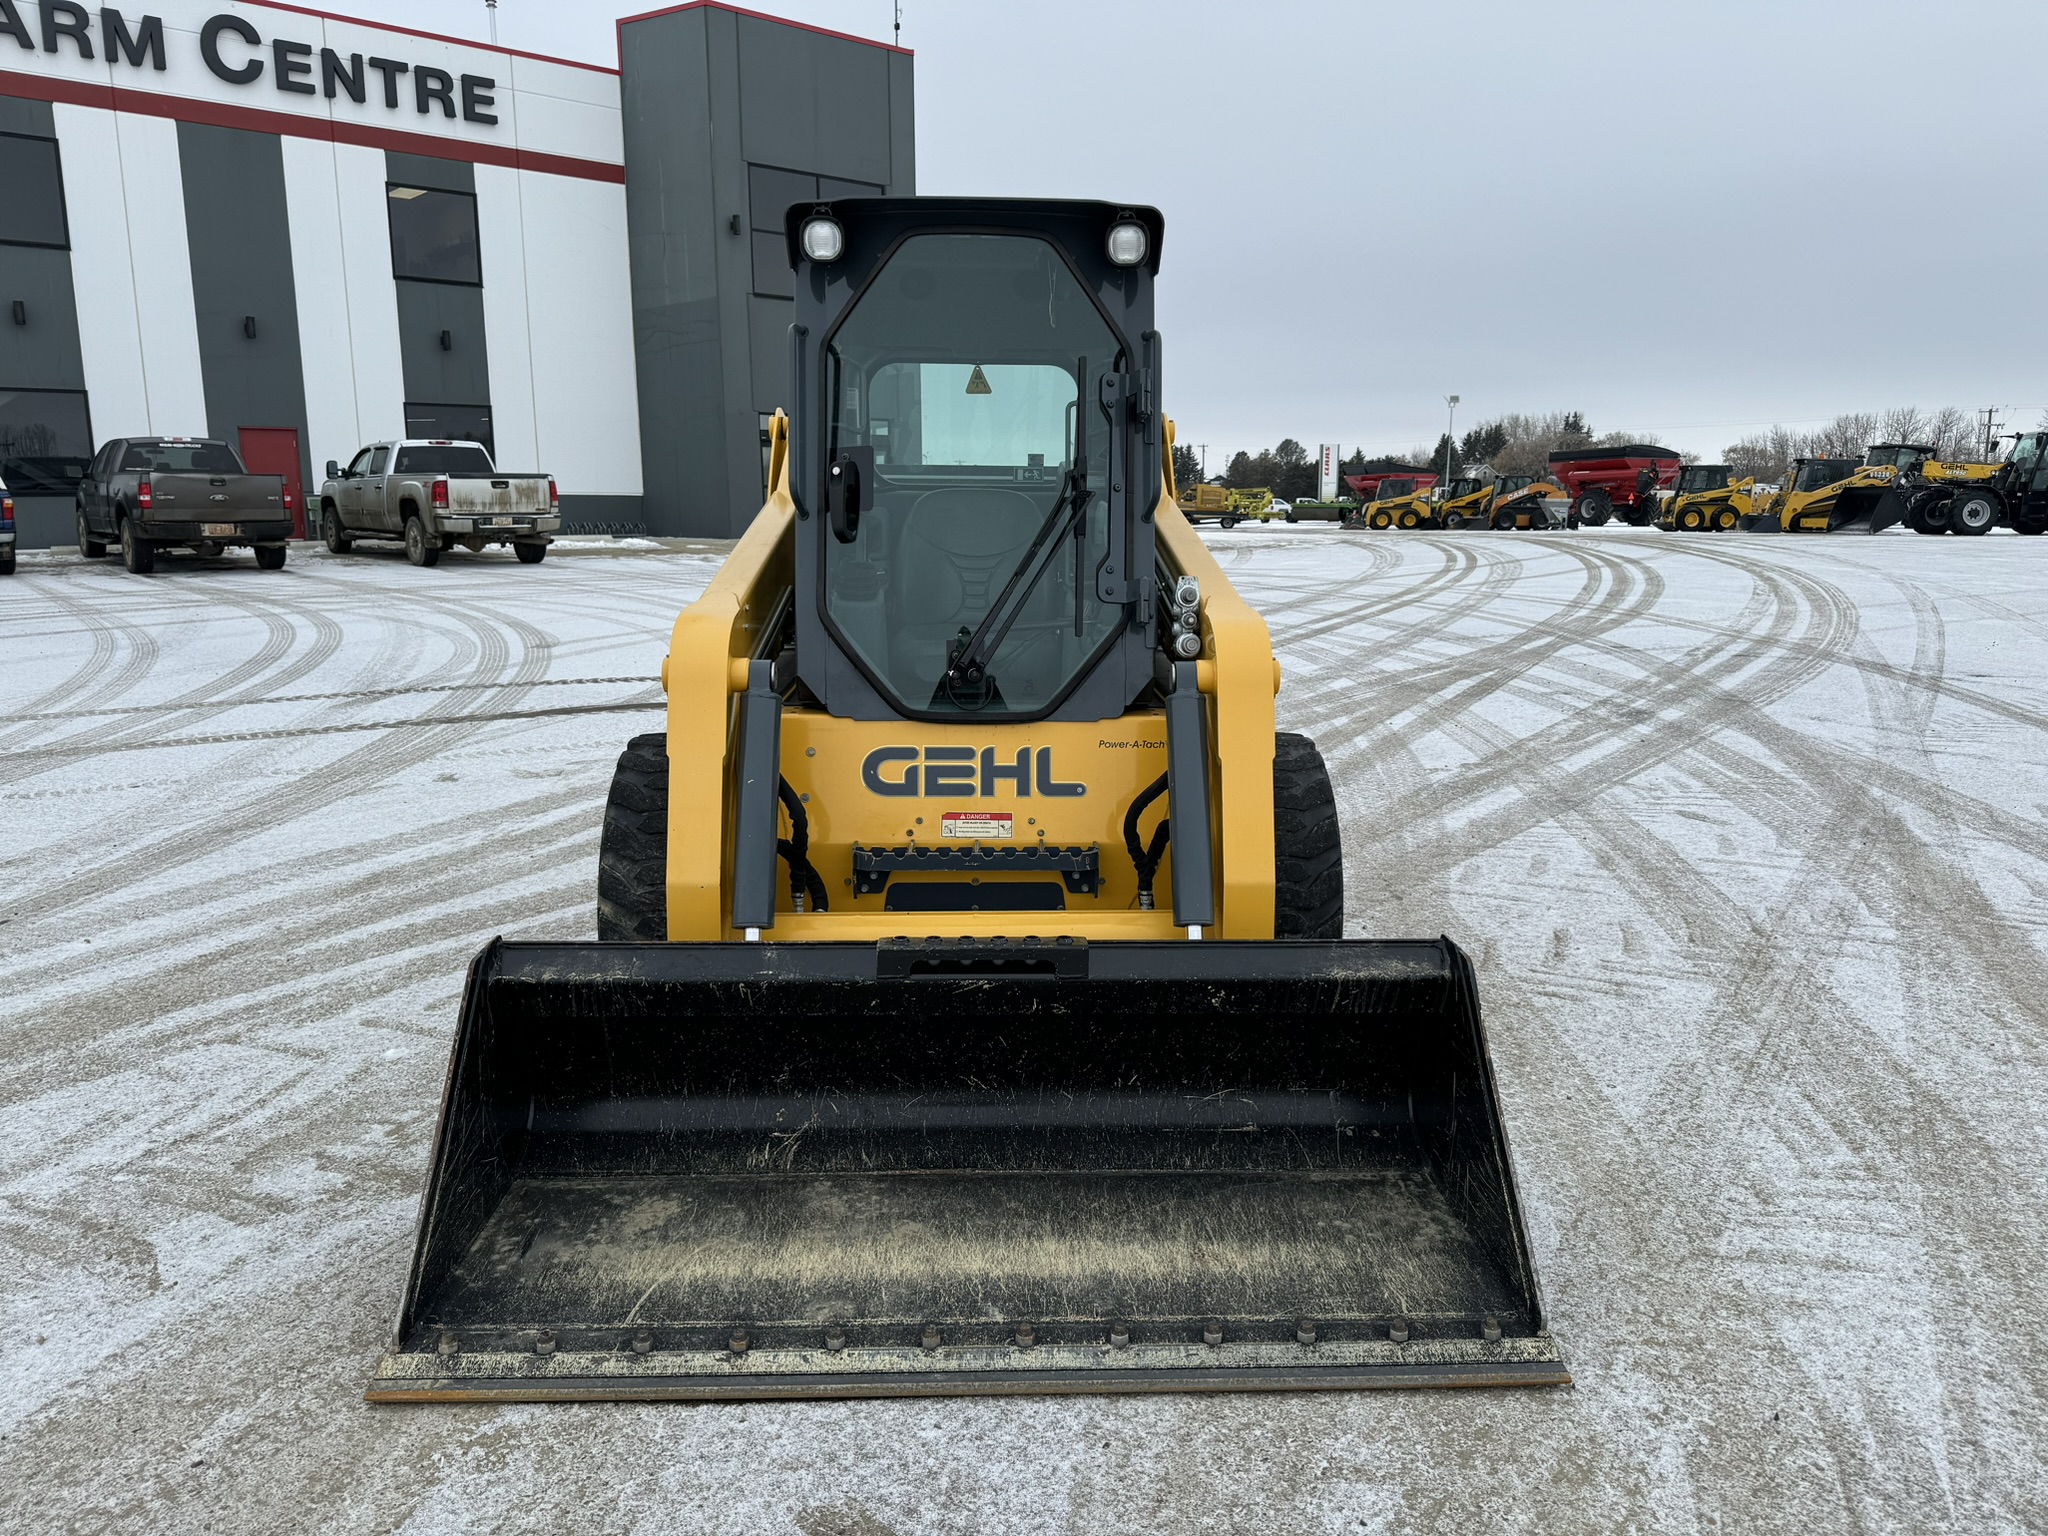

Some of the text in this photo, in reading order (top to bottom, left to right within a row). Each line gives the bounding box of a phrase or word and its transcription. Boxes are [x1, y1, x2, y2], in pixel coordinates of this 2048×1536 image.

[199, 13, 499, 126] CENTRE
[1940, 463, 1969, 471] GEHL
[1830, 480, 1857, 493] GEHL
[1507, 487, 1529, 501] CASE
[1685, 493, 1707, 502] GEHL
[1098, 739, 1166, 749] Power-A-Tach
[860, 745, 1088, 798] GEHL
